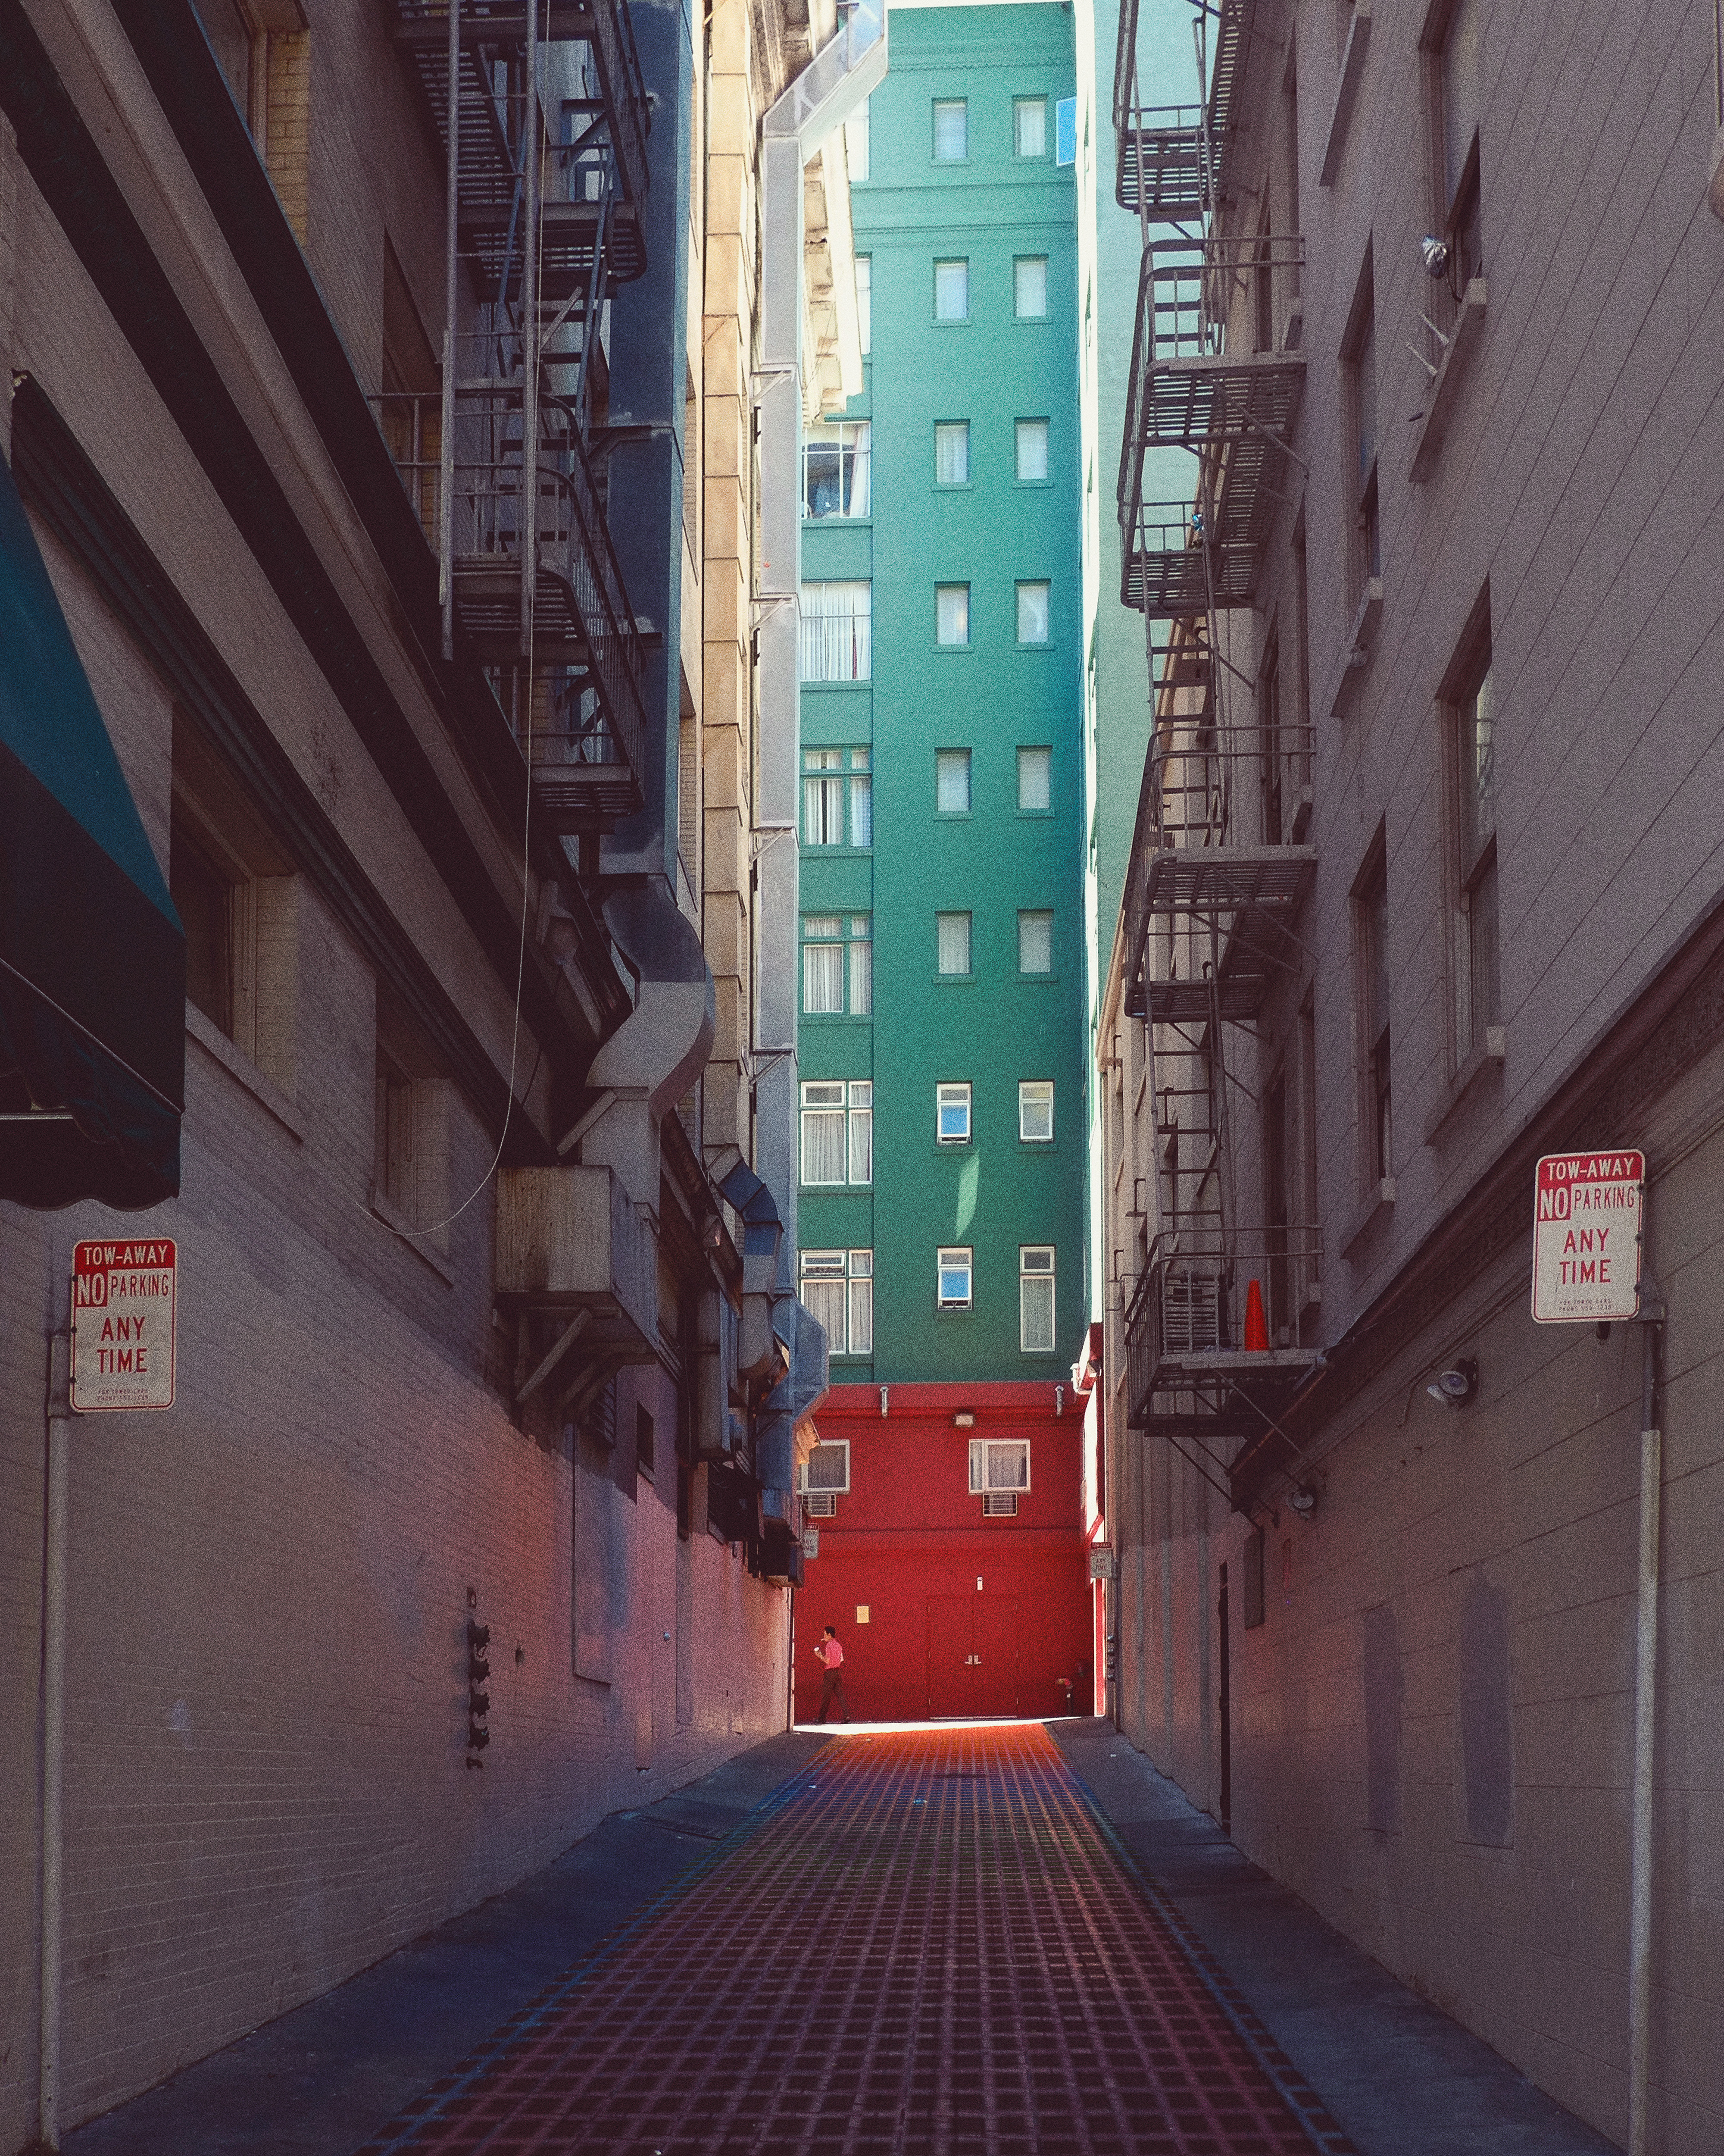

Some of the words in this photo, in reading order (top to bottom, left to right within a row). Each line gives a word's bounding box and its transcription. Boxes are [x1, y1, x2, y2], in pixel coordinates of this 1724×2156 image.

[1547, 1157, 1634, 1180] TOW-AWAY
[1540, 1187, 1568, 1220] NO
[1574, 1186, 1634, 1211] PARKING
[1564, 1227, 1610, 1254] ANY
[84, 1245, 168, 1265] TOW-AWAY
[1559, 1259, 1611, 1284] TIME
[77, 1273, 105, 1305] NO
[110, 1274, 169, 1298] PARKING
[101, 1316, 145, 1342] ANY
[97, 1348, 147, 1374] TIME
